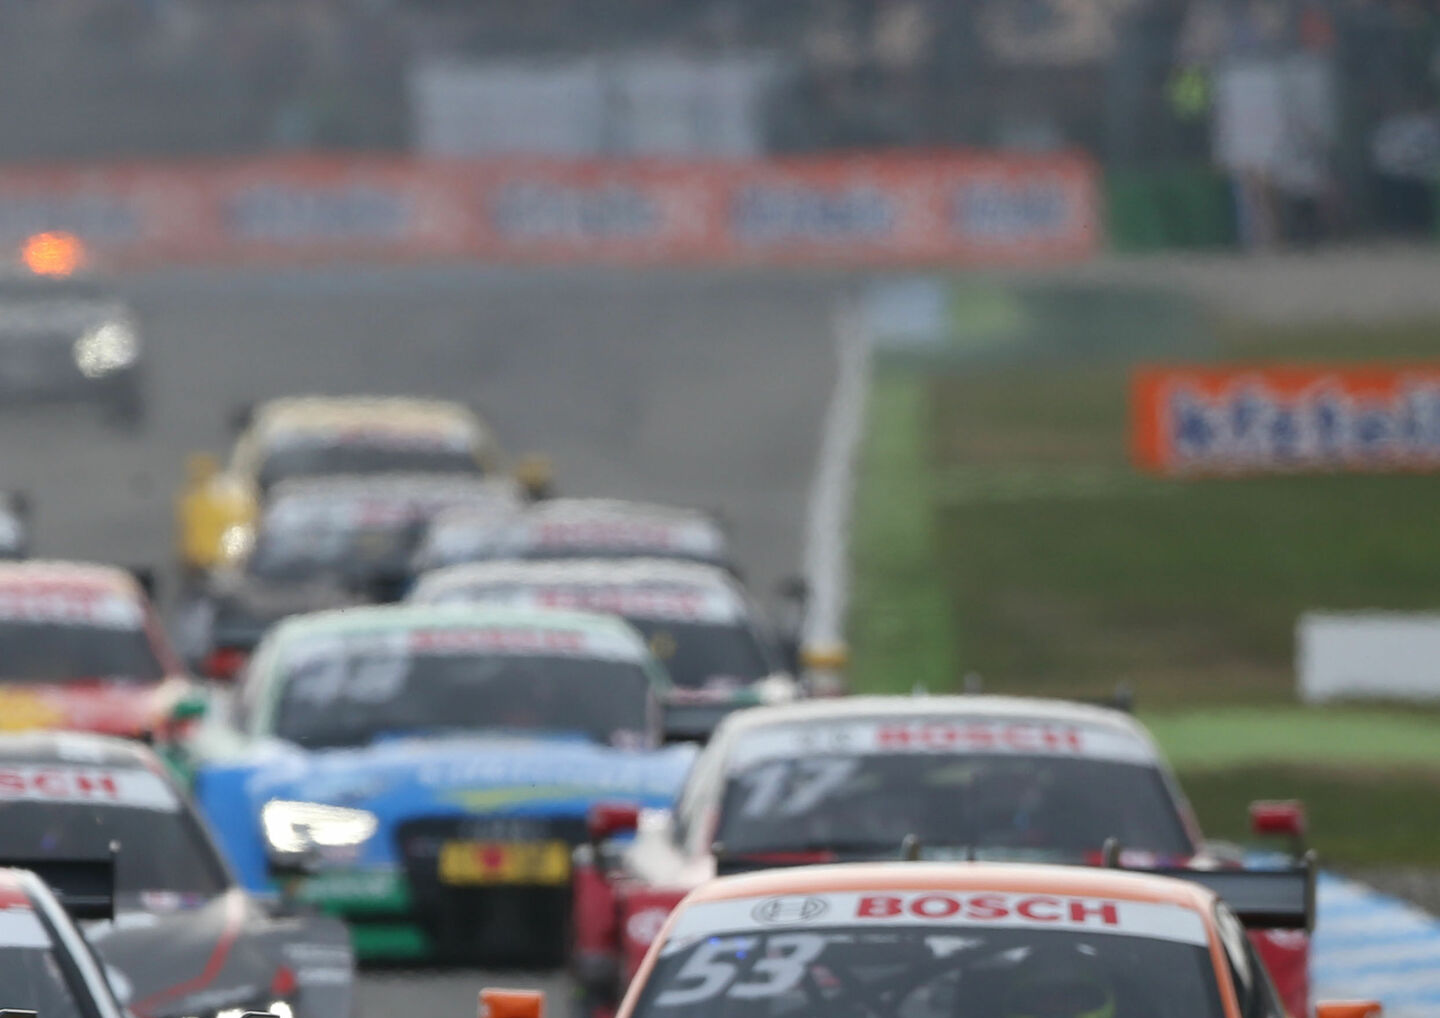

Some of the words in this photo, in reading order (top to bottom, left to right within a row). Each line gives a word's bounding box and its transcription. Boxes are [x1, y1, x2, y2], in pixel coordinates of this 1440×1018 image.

[873, 724, 1086, 754] BOSCH
[742, 758, 862, 818] 17
[854, 893, 1122, 926] BOSCH
[658, 930, 826, 1004] 53
